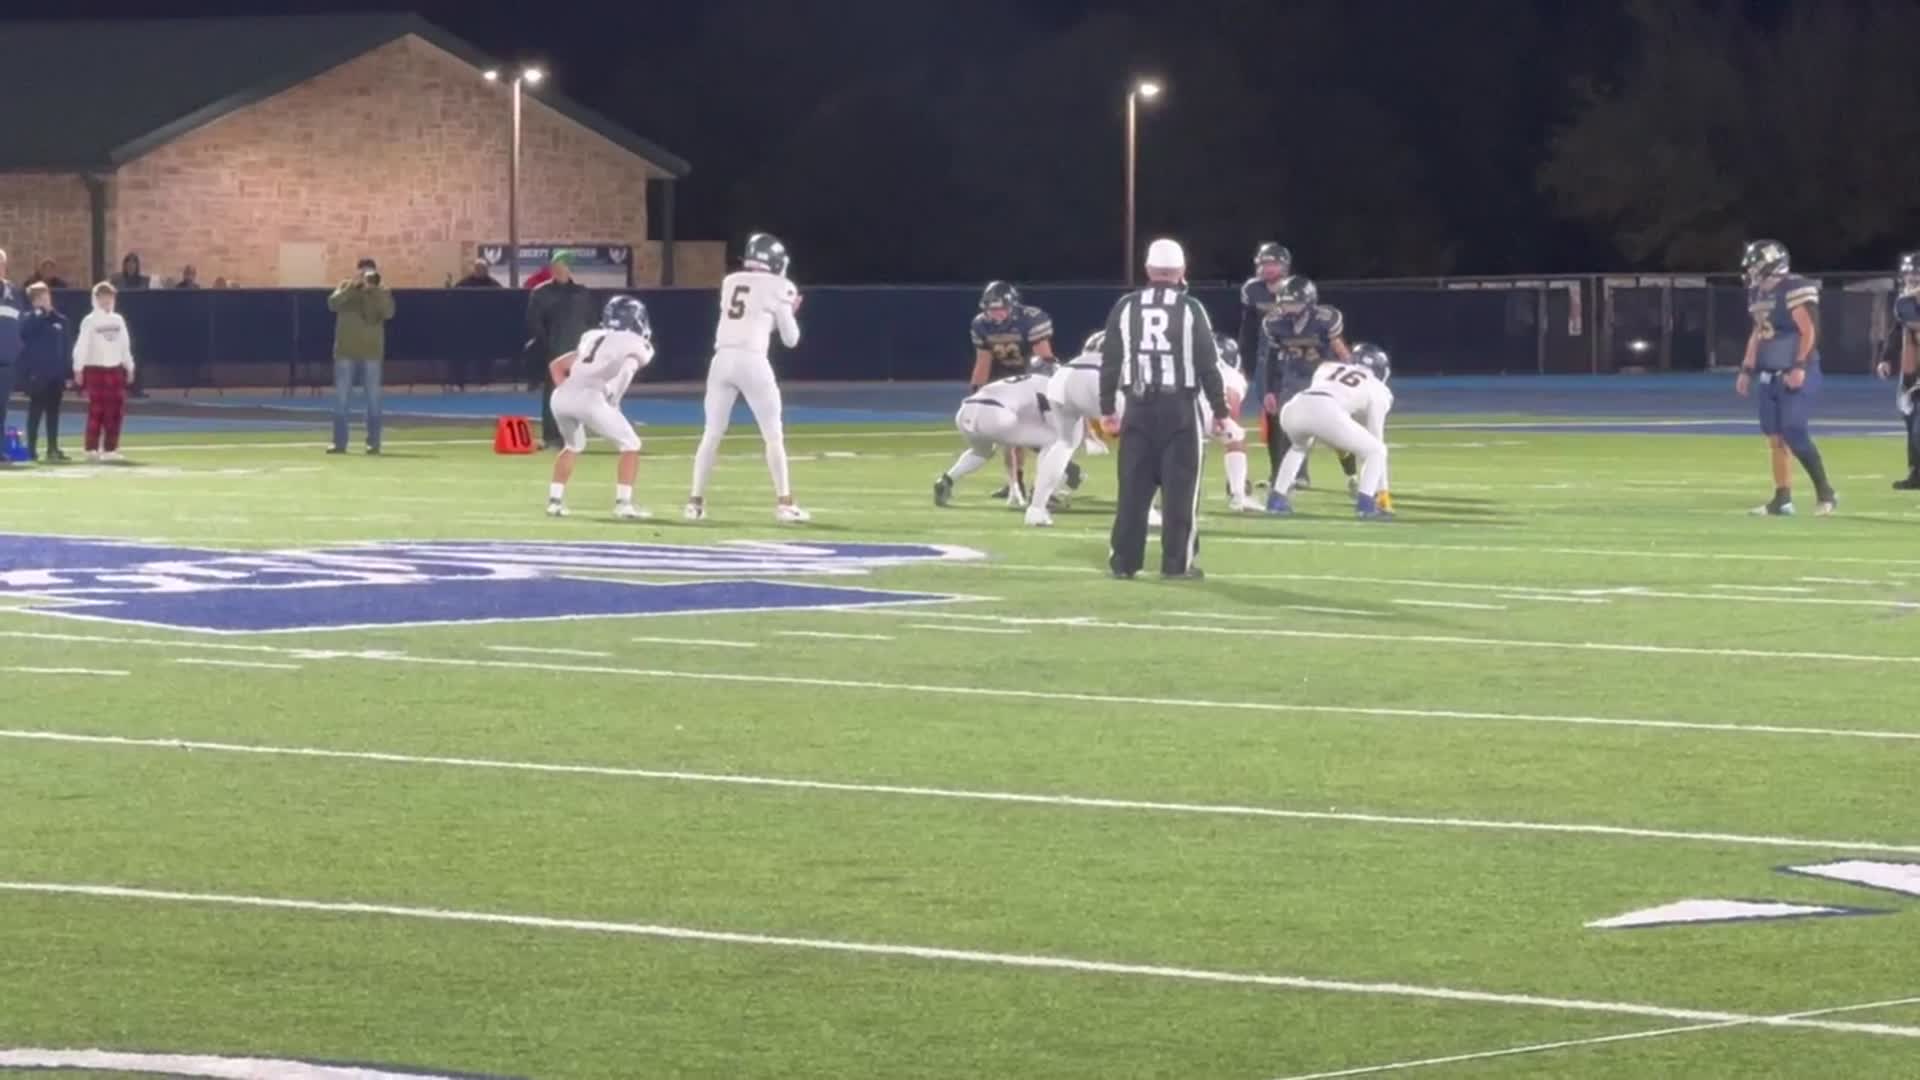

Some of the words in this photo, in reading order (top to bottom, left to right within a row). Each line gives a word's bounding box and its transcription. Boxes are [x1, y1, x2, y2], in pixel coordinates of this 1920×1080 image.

[728, 285, 750, 320] 5
[1140, 308, 1171, 351] R
[582, 335, 606, 364] 1
[1327, 366, 1367, 388] 16
[505, 420, 531, 449] 10
